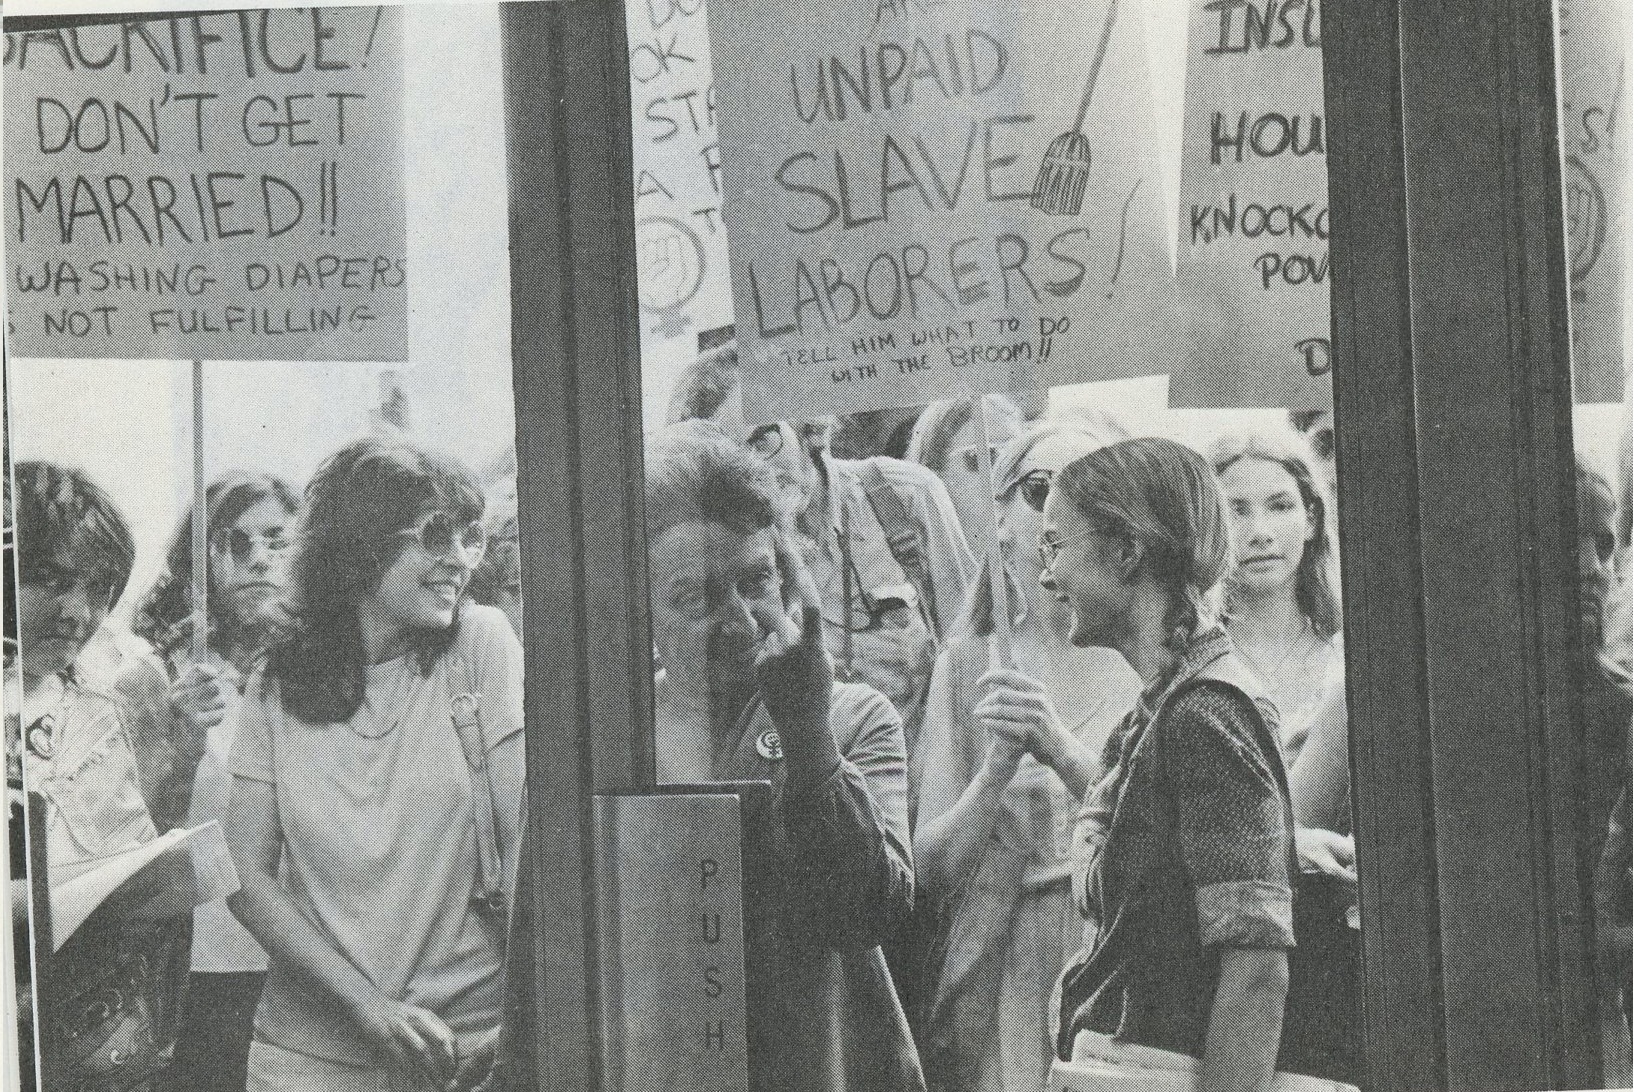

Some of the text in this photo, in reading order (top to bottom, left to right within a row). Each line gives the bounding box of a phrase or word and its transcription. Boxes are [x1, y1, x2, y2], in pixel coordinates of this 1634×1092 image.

[790, 29, 1009, 124] UNPAID
[37, 83, 366, 154] DON'T GET
[15, 161, 338, 246] MARRIED!!
[774, 114, 1041, 234] SLAVE
[15, 254, 406, 296] WASHING DIAPERS
[749, 178, 1143, 339] LABORERS!
[43, 305, 119, 338] NOT
[150, 303, 376, 337] FULFILLING
[779, 316, 1071, 367] TELL HIM WHAT TO DO
[830, 336, 1053, 384] WITH THE BROOM!!
[701, 858, 724, 1051] PUSH
